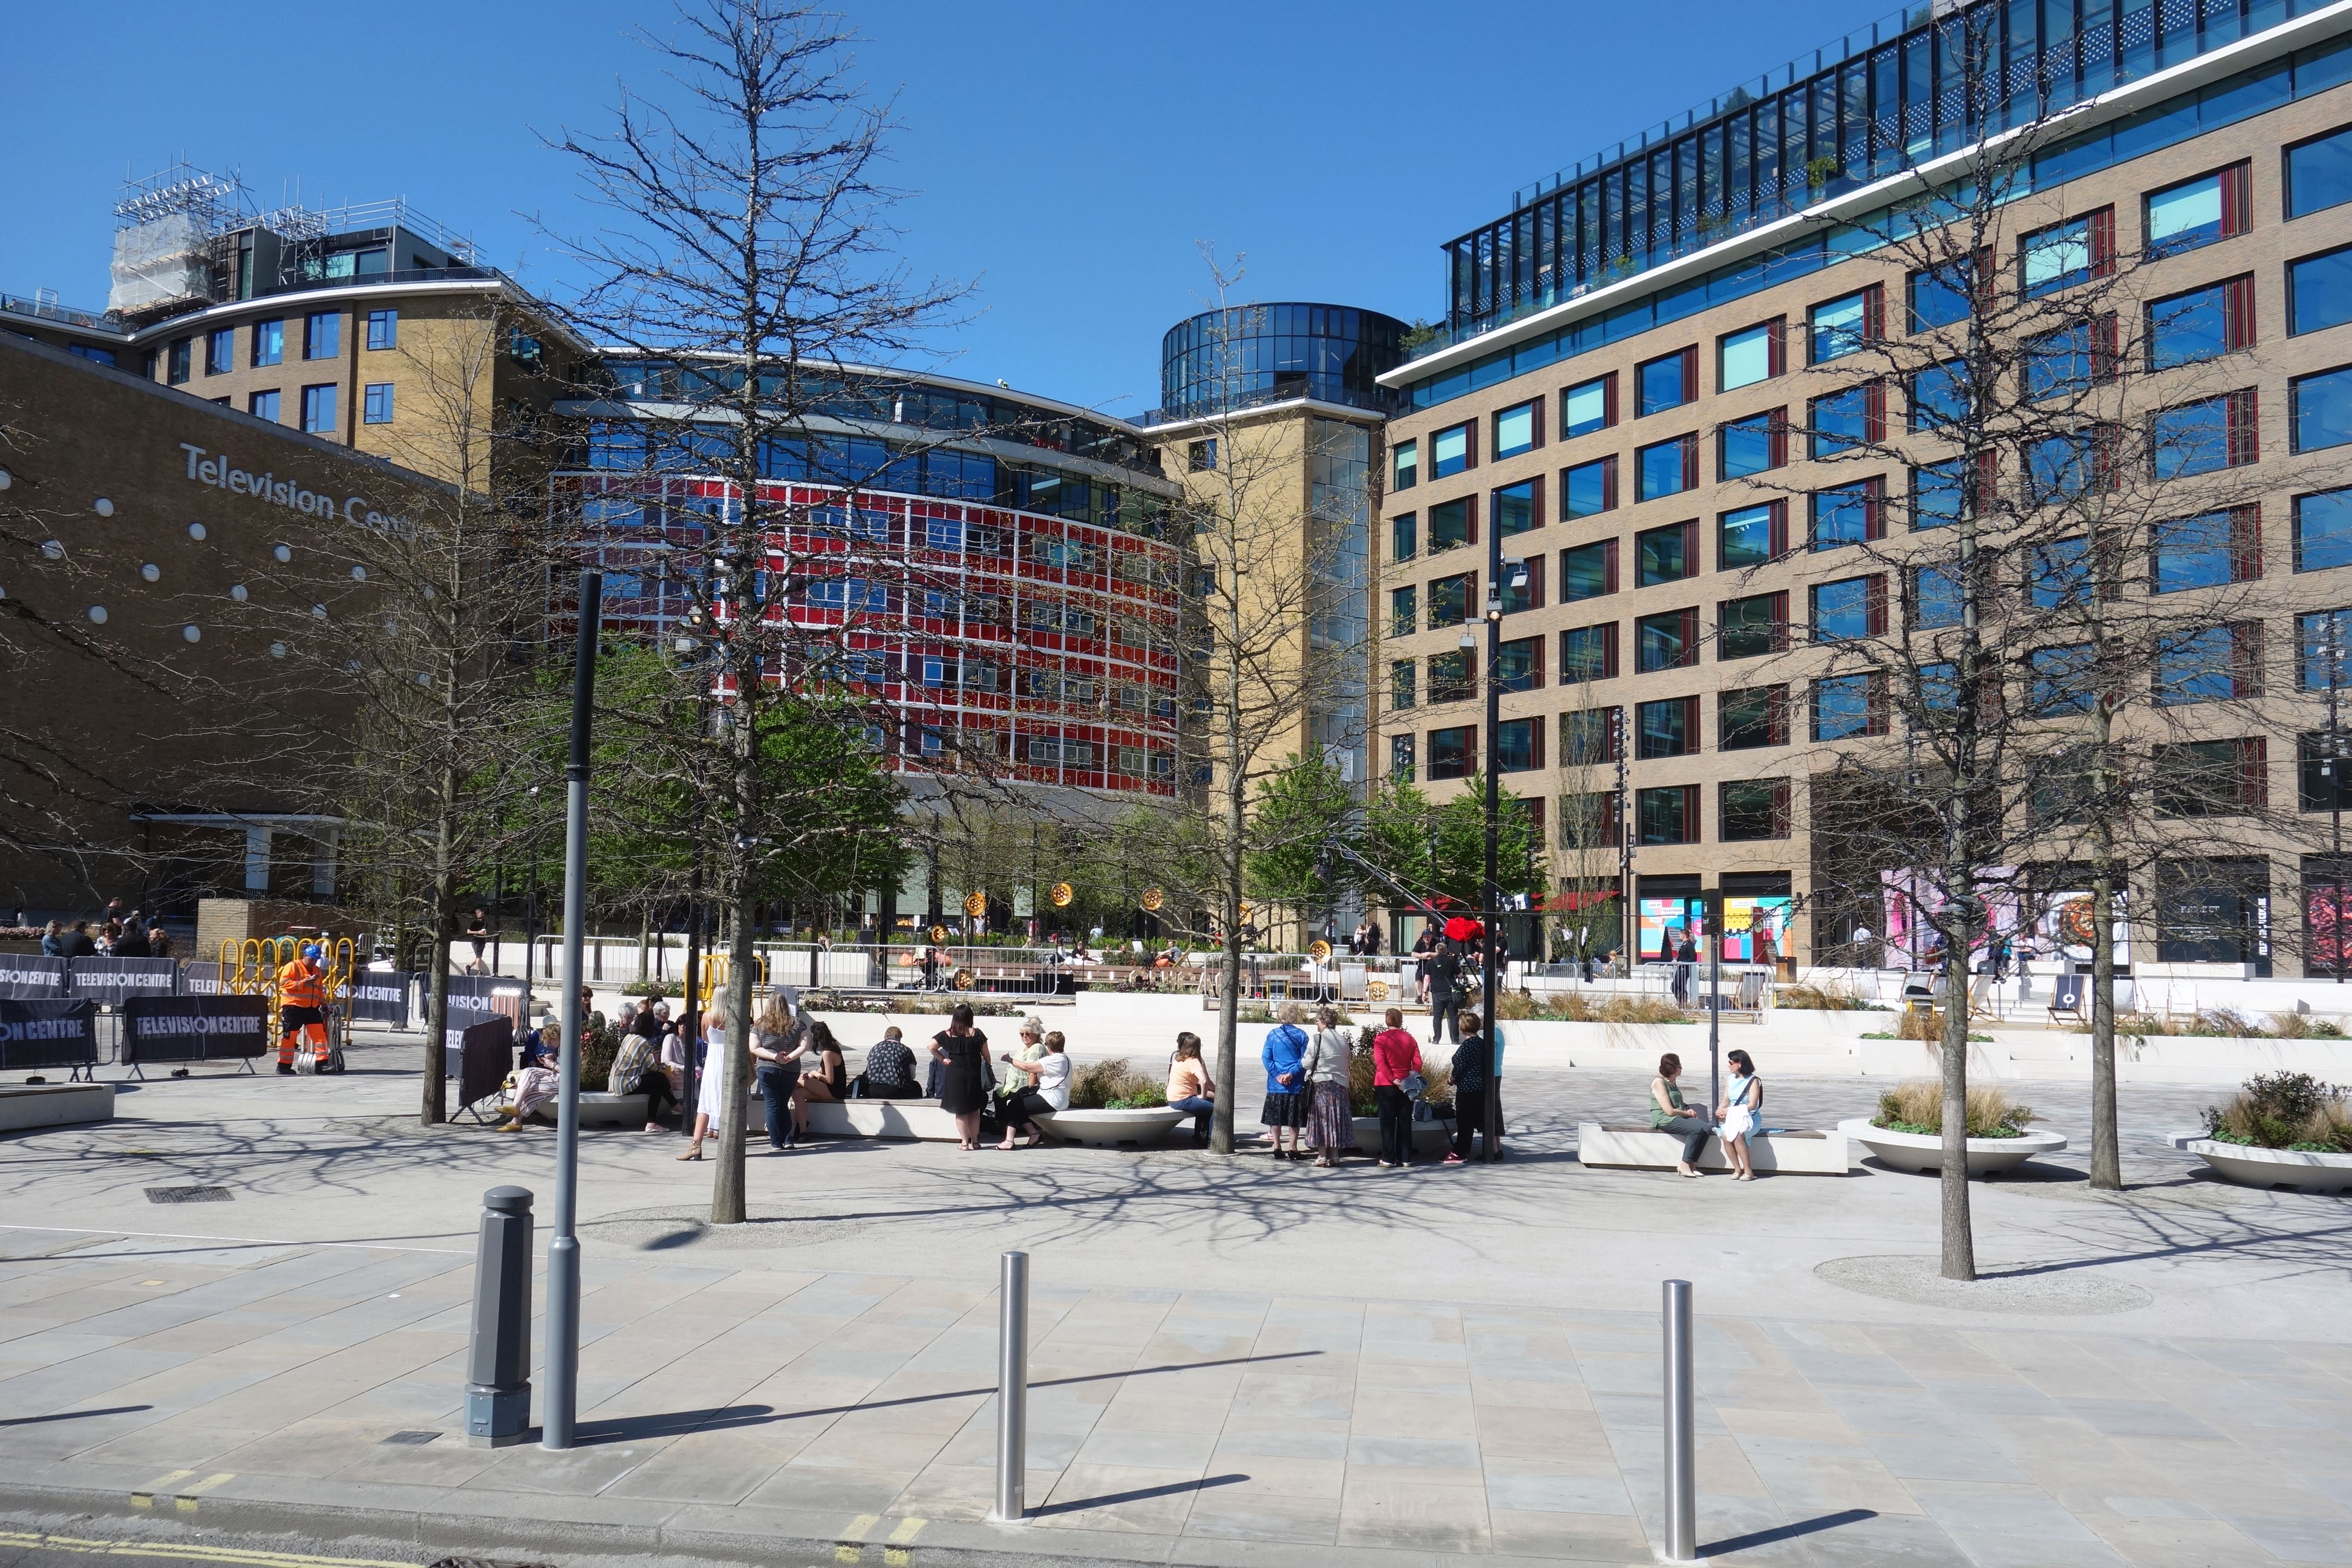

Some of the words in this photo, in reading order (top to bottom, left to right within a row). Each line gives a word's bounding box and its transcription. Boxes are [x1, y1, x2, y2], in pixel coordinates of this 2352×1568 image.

[180, 443, 334, 520] Television
[75, 973, 134, 987] TELEVISION
[135, 973, 172, 987] CENTRE
[367, 986, 402, 1002] CENTRE
[26, 1019, 85, 1040] CENTRE
[136, 1016, 218, 1034] TELEVISION
[218, 1016, 261, 1033] CENTRE
